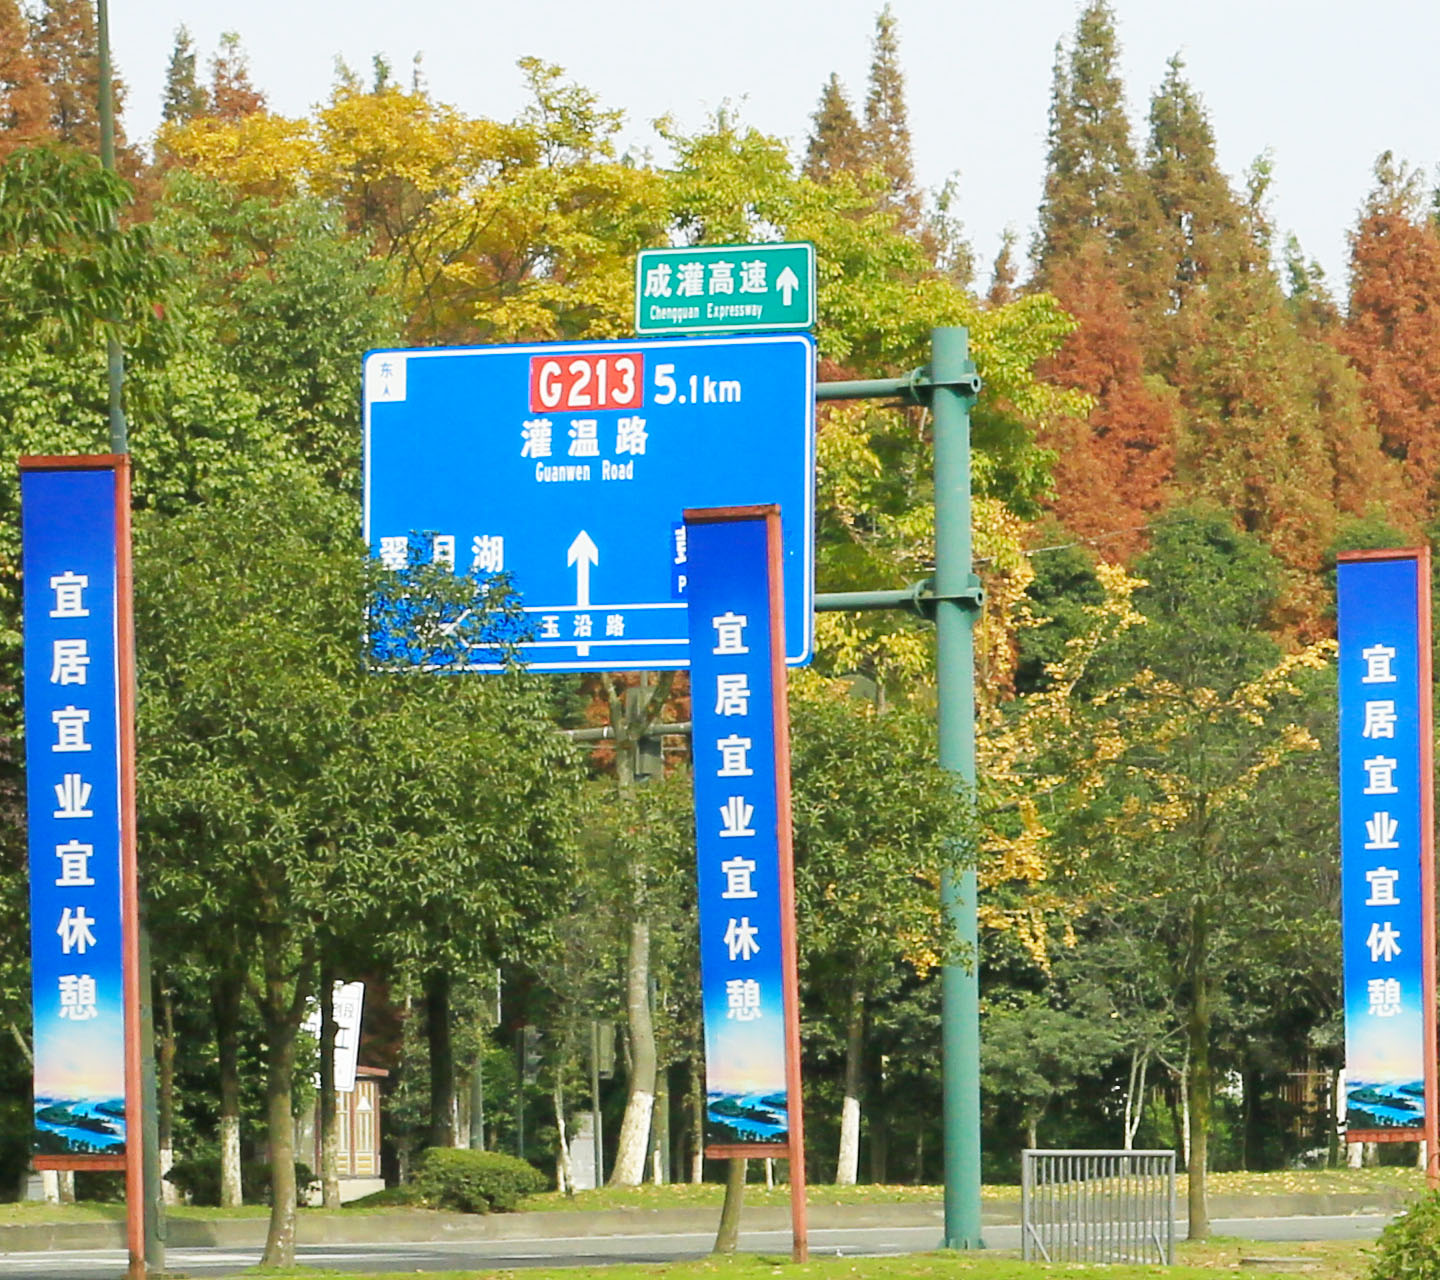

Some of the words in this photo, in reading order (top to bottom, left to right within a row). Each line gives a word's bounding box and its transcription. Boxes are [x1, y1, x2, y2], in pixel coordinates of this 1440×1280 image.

[643, 259, 768, 298] 成灌高速
[650, 304, 700, 323] Chengguan
[706, 302, 763, 320] Expressway
[538, 357, 636, 408] G213
[520, 415, 649, 458] 灌温路
[535, 461, 591, 482] Guanwen
[601, 459, 634, 480] Road
[540, 614, 626, 639] 玉沿路
[49, 570, 99, 1021] 宜居宜业宜休憩
[711, 611, 762, 1022] 宜居宜业宜休憩
[1361, 643, 1403, 1018] 宜居宜业宜休憩
